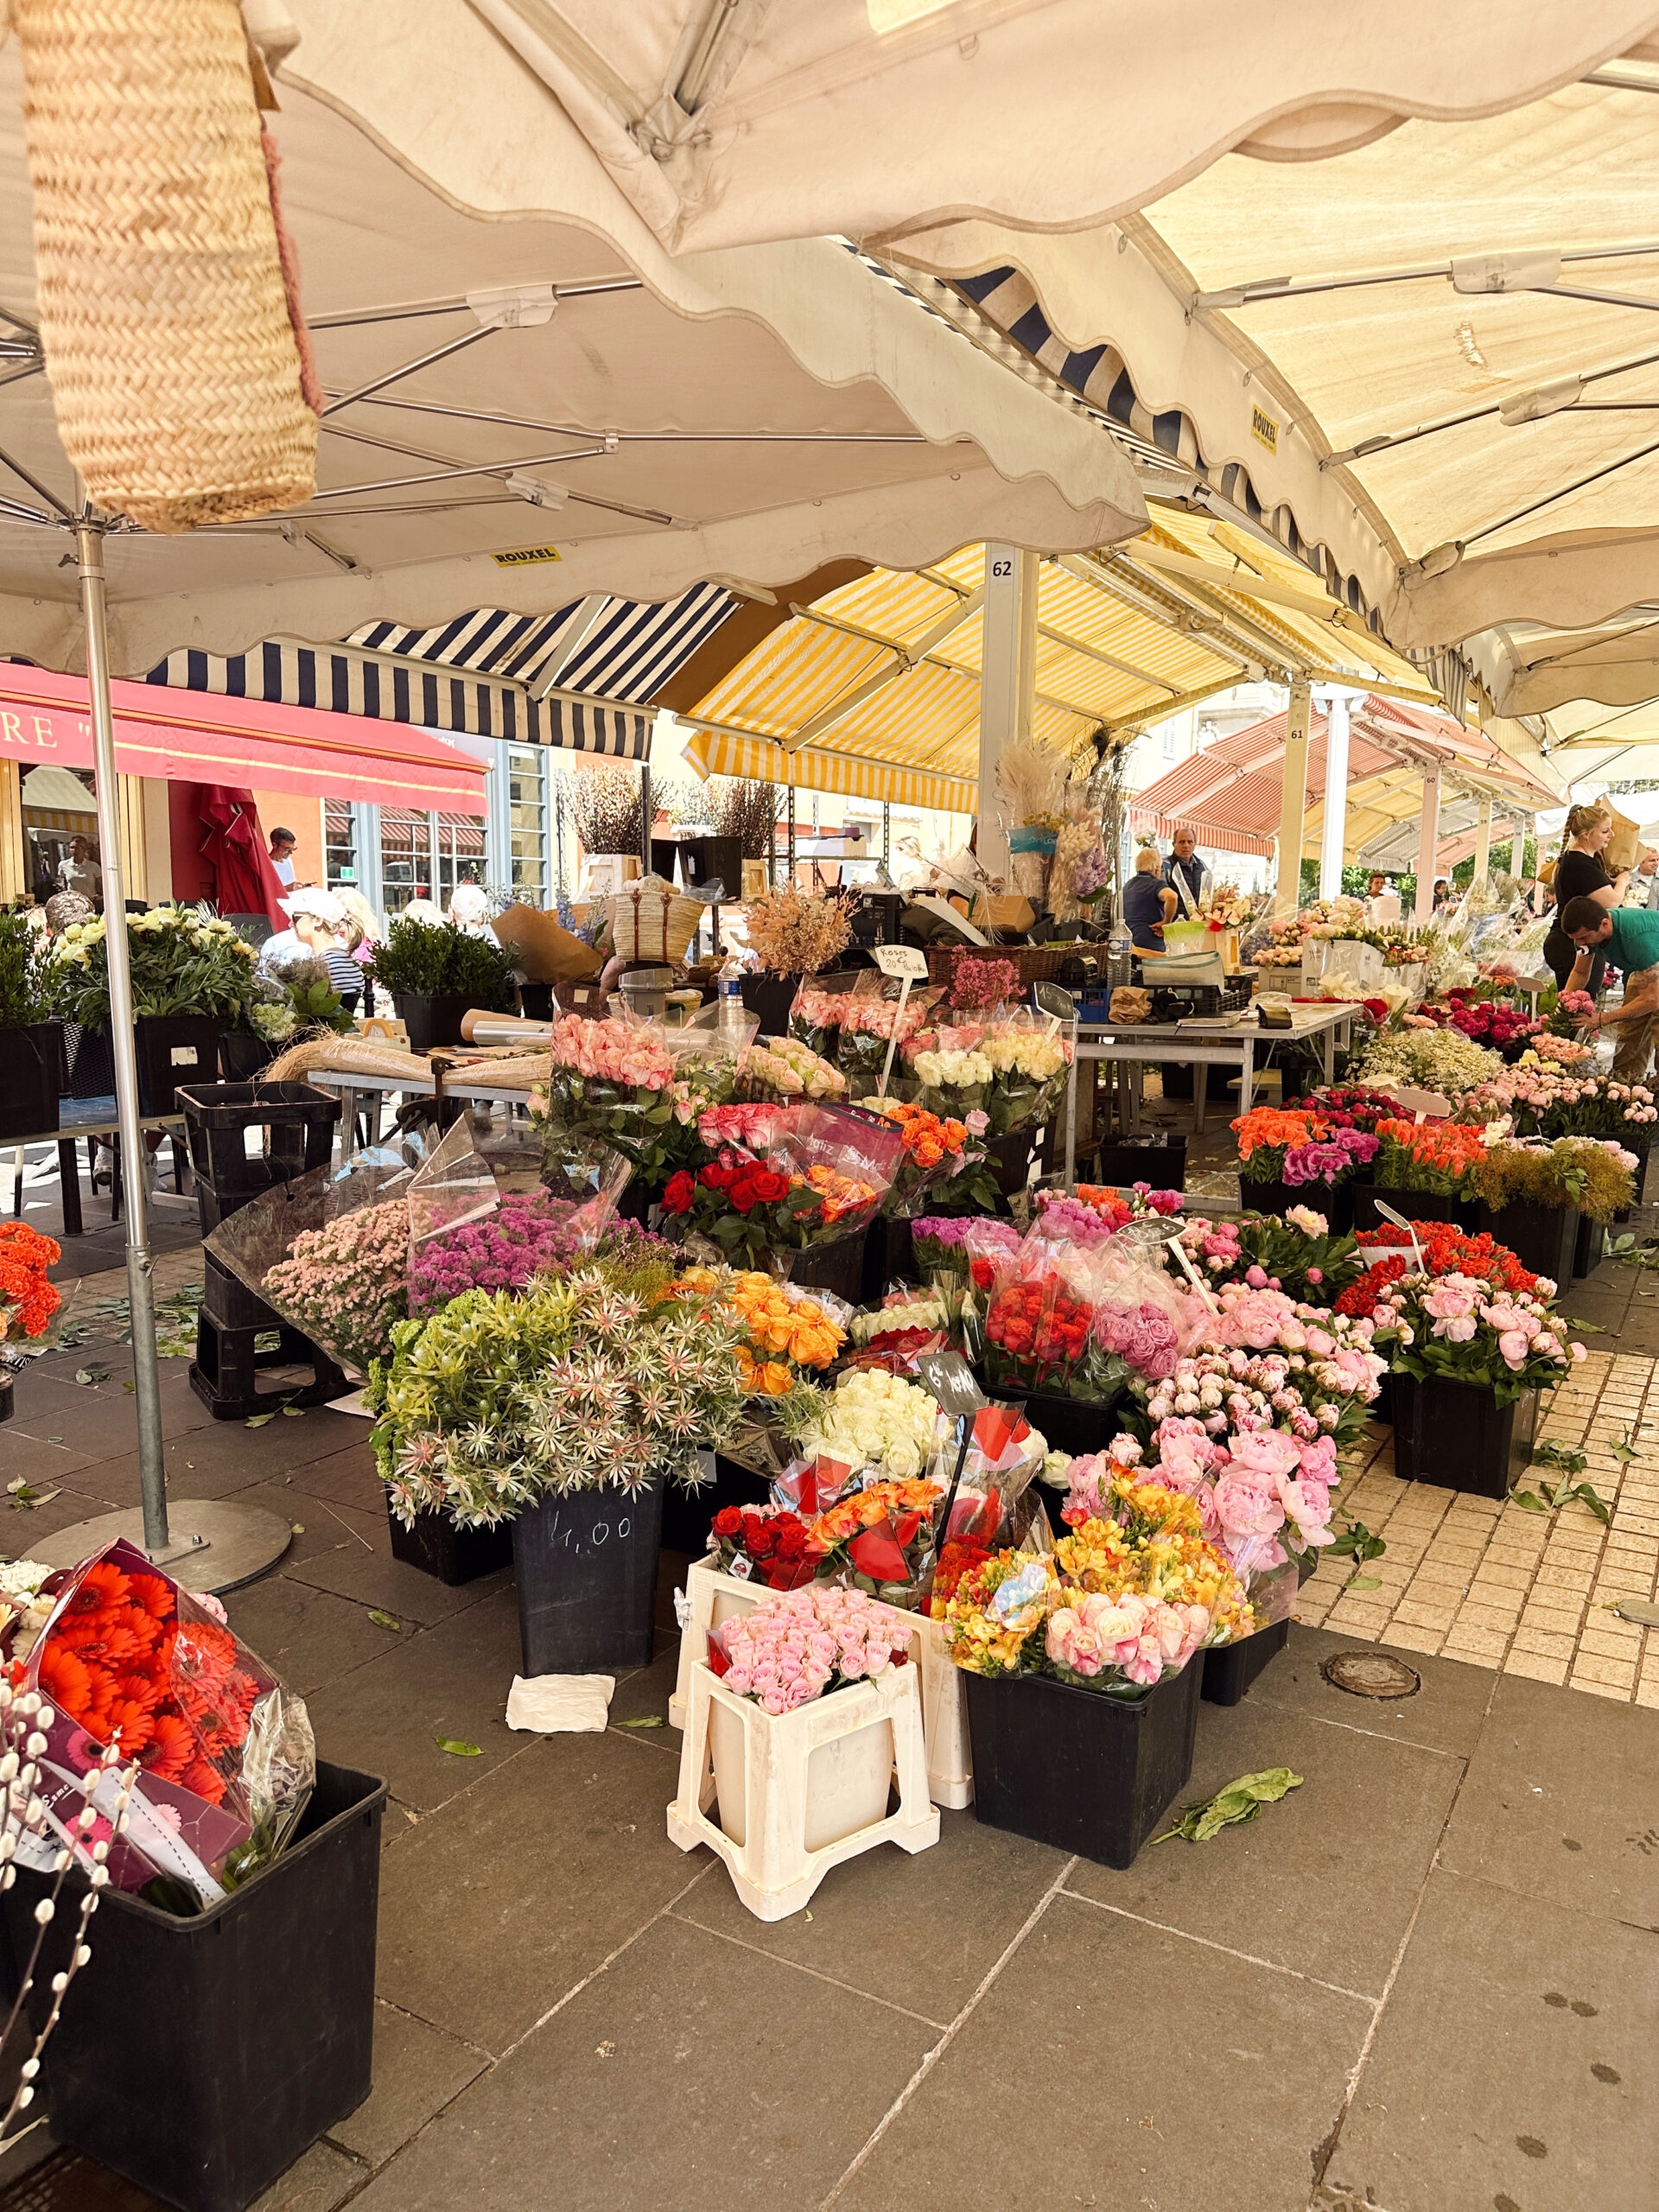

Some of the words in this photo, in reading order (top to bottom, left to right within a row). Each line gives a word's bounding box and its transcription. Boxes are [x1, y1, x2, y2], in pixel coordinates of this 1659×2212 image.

[1253, 409, 1275, 444] ROUXEL
[494, 548, 556, 563] ROUXEL
[993, 561, 1011, 576] 62
[1291, 729, 1303, 739] 61
